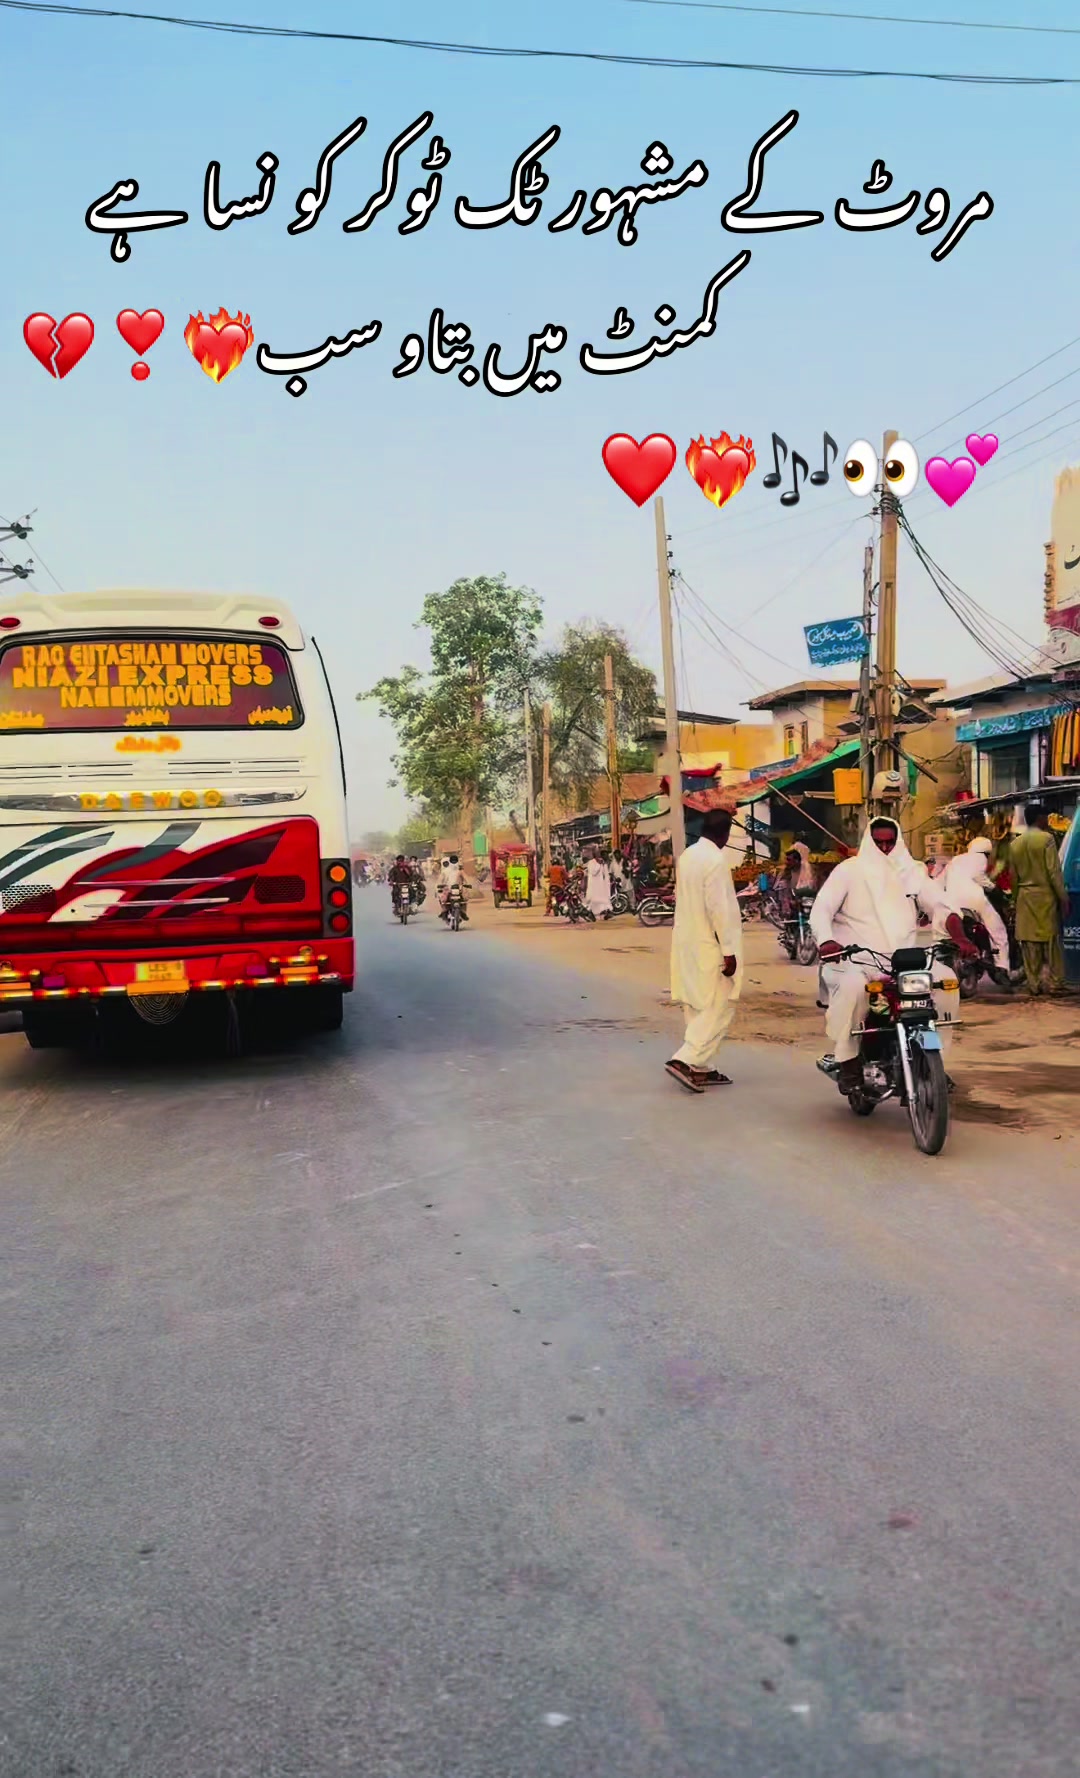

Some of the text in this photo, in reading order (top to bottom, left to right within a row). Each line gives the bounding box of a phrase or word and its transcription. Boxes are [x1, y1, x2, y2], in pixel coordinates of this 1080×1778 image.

[22, 645, 64, 667] RAO
[181, 643, 263, 665] MOVERS
[13, 664, 274, 688] NIAZI EXPRESS
[79, 790, 223, 810] DAEWOO
